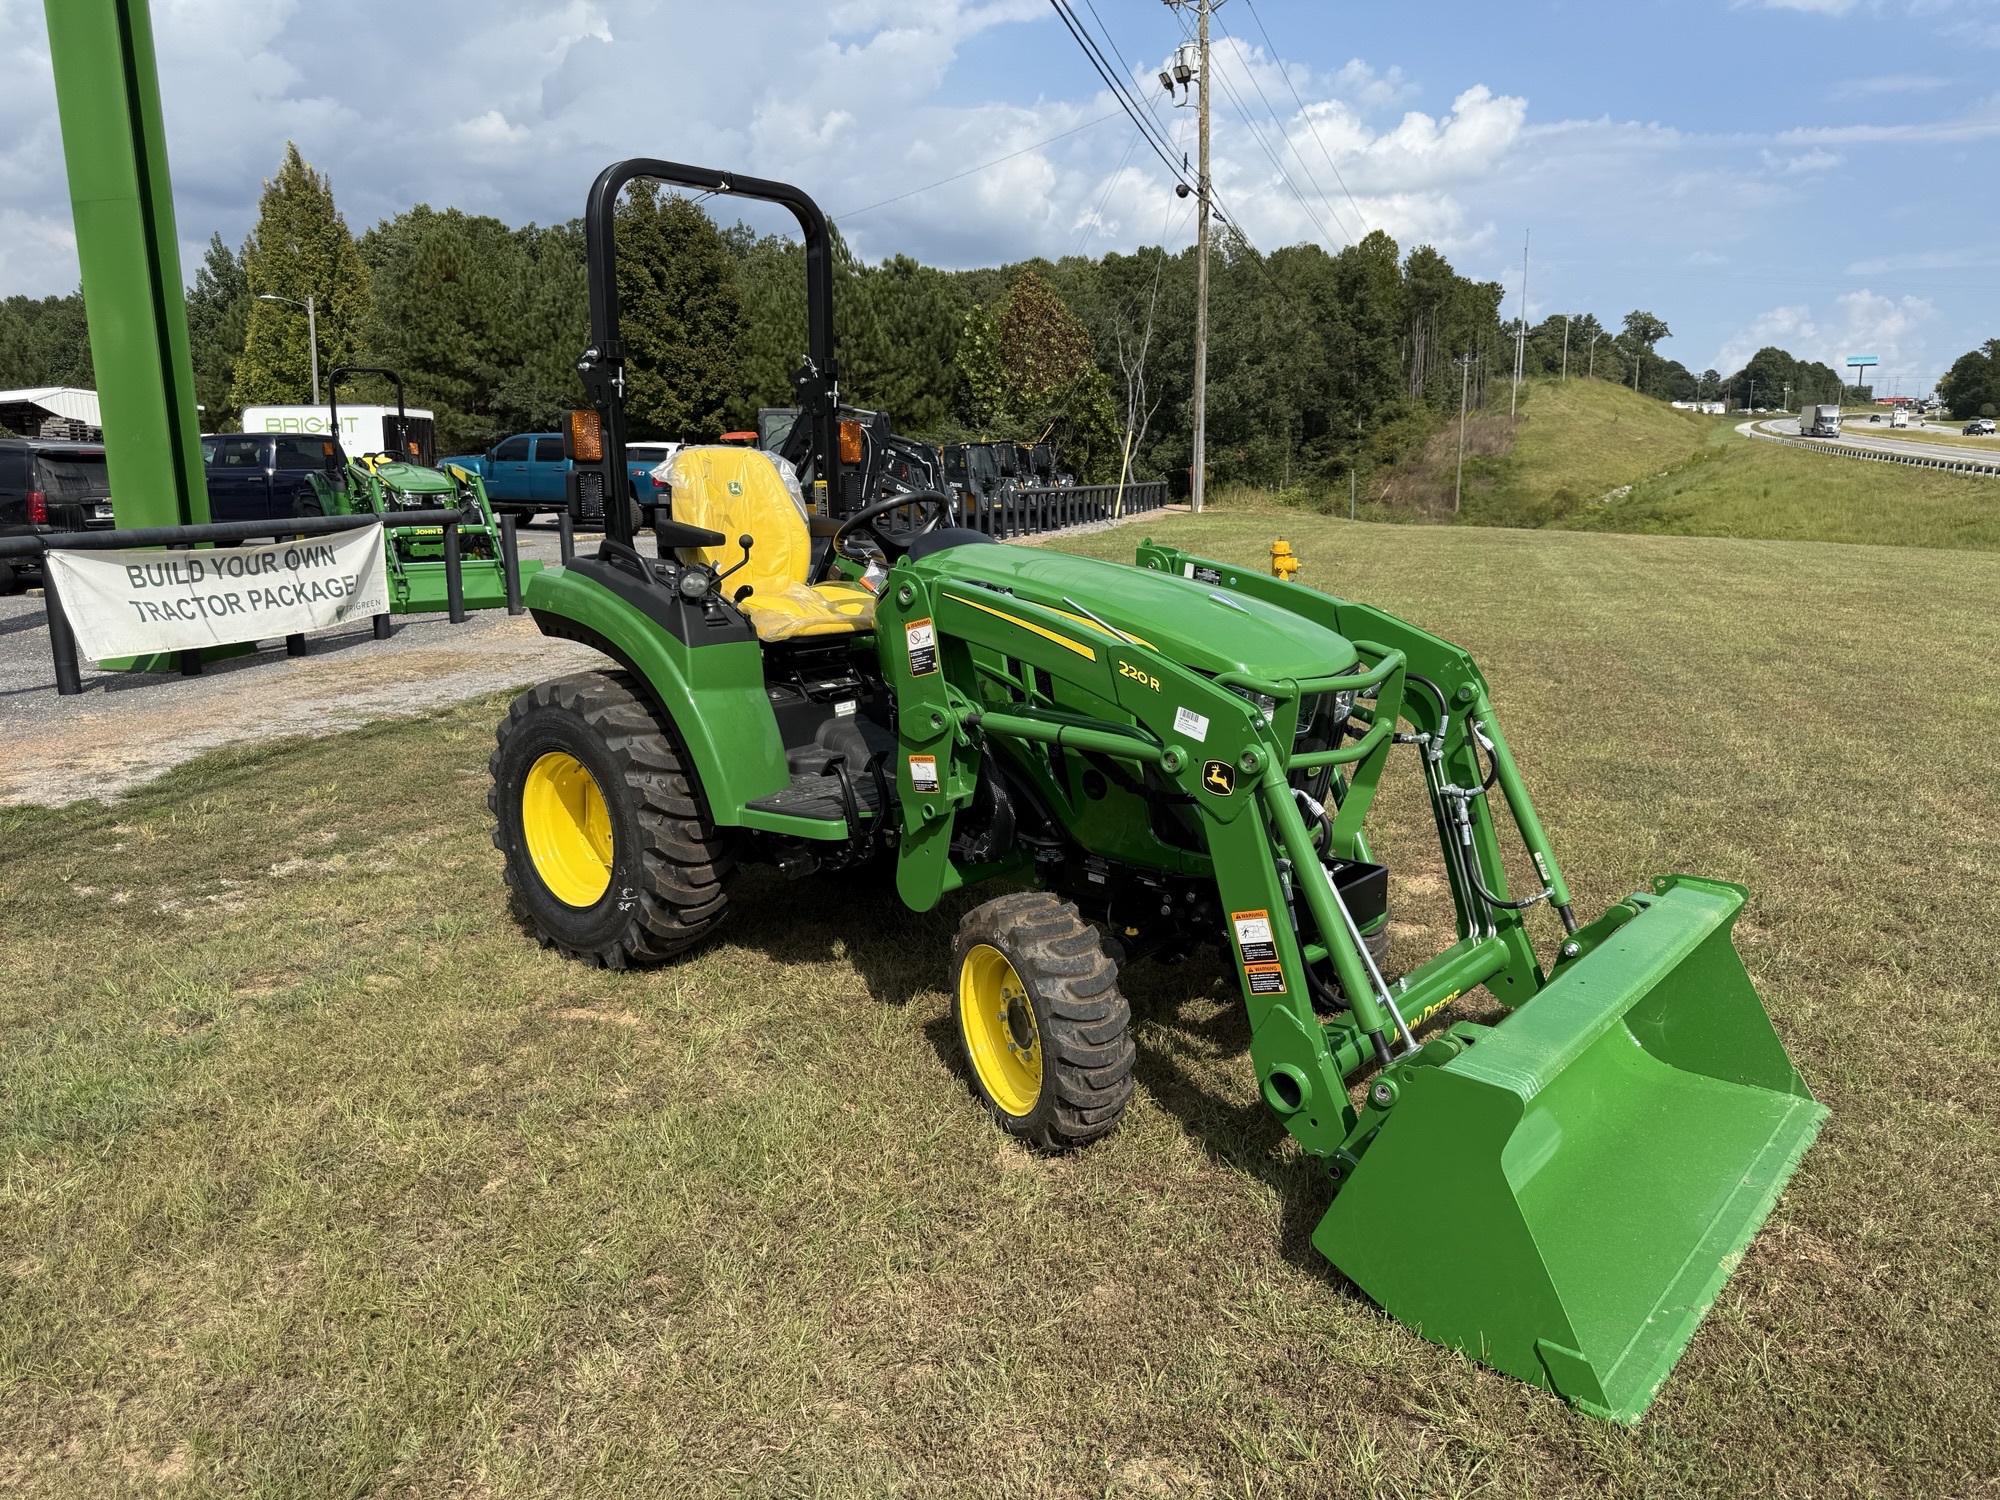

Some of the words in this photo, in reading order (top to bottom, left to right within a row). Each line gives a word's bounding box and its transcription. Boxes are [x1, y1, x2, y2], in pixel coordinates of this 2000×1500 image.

[265, 416, 359, 433] BRIGHT
[125, 559, 205, 589] BUILD
[210, 552, 279, 580] YOUR
[284, 544, 337, 571] OWN
[129, 592, 246, 623] TRACTOR
